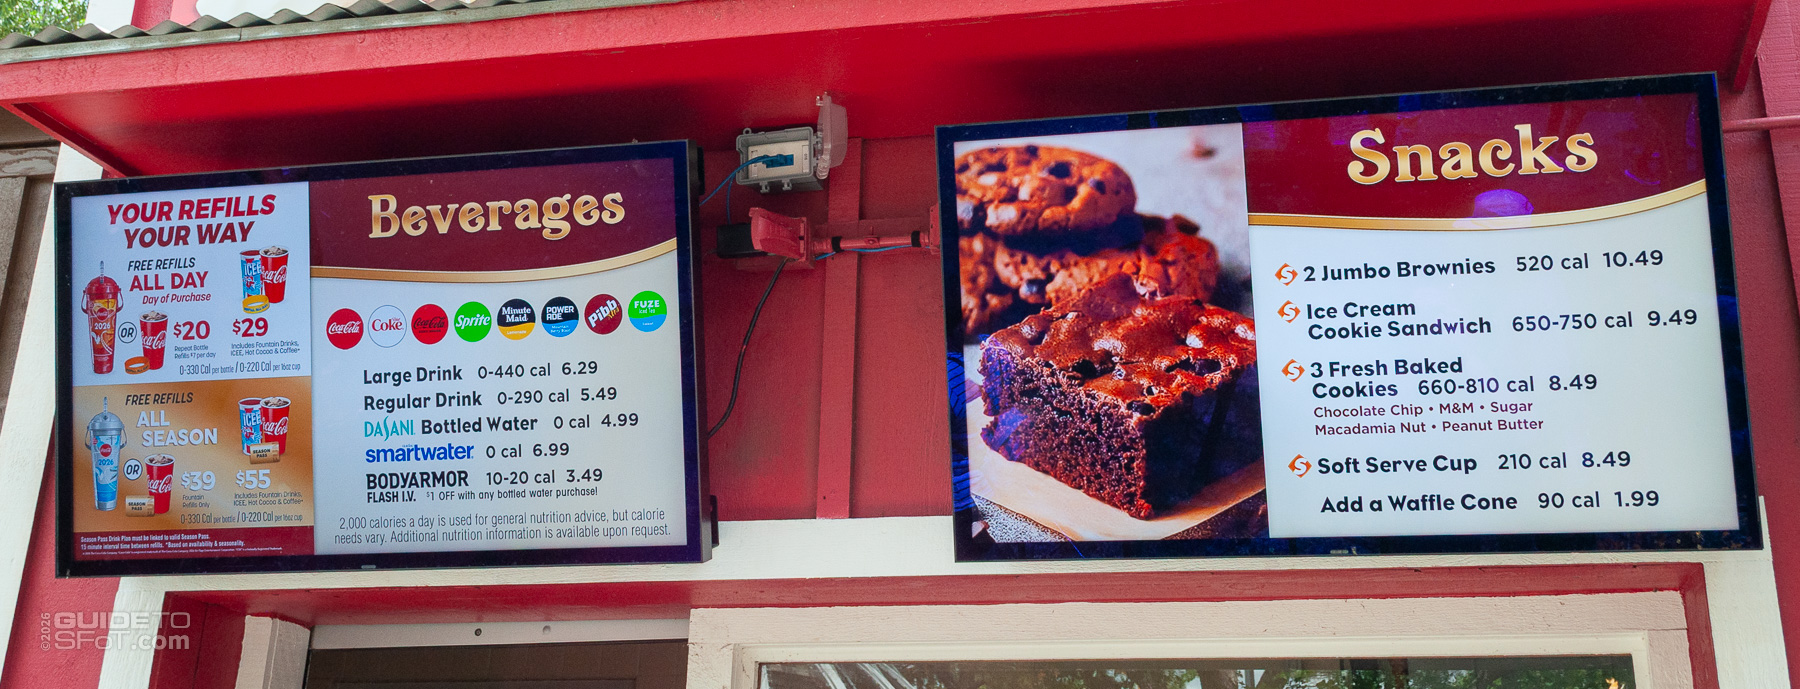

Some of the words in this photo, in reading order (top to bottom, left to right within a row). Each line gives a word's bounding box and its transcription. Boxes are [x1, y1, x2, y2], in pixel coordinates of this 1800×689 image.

[1347, 123, 1598, 185] Snacks
[107, 201, 173, 224] YOUR
[178, 194, 276, 220] REFILLS
[367, 192, 626, 241] Beverages
[124, 226, 190, 249] YOUR
[197, 221, 255, 244] WAY
[128, 259, 153, 271] FREE
[155, 257, 196, 270] REFILLS
[1303, 265, 1316, 282] 2
[1321, 262, 1390, 281] Jumbo
[1397, 258, 1496, 278] Brownies
[1515, 255, 1554, 272] 520
[1561, 253, 1589, 270] cal
[1603, 250, 1663, 268] 10.49
[129, 274, 164, 291] ALL
[171, 271, 208, 289] DAY
[142, 295, 159, 305] Day
[161, 294, 170, 303] of
[171, 292, 211, 303] Purchase
[634, 300, 660, 308] FUZE
[502, 306, 531, 315] Minute
[506, 314, 528, 322] Maid
[546, 305, 574, 313] POWER
[588, 299, 617, 328] Pibb
[1307, 303, 1337, 320] Ice
[1343, 300, 1416, 318] Cream
[173, 321, 210, 340] $20
[232, 317, 269, 338] $29
[372, 318, 403, 332] Coke
[456, 314, 491, 330] Sprite
[1308, 322, 1382, 341] Cookie
[1388, 317, 1492, 338] Sandwich
[1512, 313, 1597, 333] 650-750
[1604, 312, 1633, 329] cal
[1647, 309, 1697, 327] 9.49
[121, 328, 134, 337] OR
[363, 370, 412, 387] Large
[416, 365, 463, 382] Drink
[478, 364, 525, 380] 0-440
[530, 363, 551, 377] cal
[561, 361, 598, 375] 6.29
[1310, 362, 1323, 379] 3
[1329, 360, 1388, 378] Fresh
[1394, 357, 1463, 375] Baked
[1312, 380, 1398, 399] Cookies
[1418, 377, 1500, 396] 660-810
[1506, 376, 1535, 393] cal
[1549, 374, 1597, 391] 8.49
[125, 394, 151, 406] FREE
[153, 392, 193, 404] REFILLS
[364, 394, 431, 413] Regular
[435, 391, 482, 407] Drink
[497, 390, 543, 405] 0-290
[548, 388, 570, 403] cal
[580, 387, 617, 401] 5.49
[137, 410, 170, 428] ALL
[1313, 404, 1386, 419] Chocolate
[1390, 403, 1424, 419] Chip
[1439, 401, 1474, 415] M&M
[1490, 400, 1533, 418] Sugar
[364, 415, 415, 442] DASANI
[421, 417, 482, 435] Bottled
[486, 416, 538, 432] Water
[553, 415, 564, 429] 0
[569, 414, 590, 429] cal
[601, 413, 639, 427] 4.99
[1315, 422, 1396, 436] Macadamia
[1400, 421, 1426, 434] Nut
[1442, 419, 1493, 433] Peanut
[1498, 417, 1544, 431] Butter
[142, 428, 218, 447] SEASON
[365, 443, 473, 464] smartwater
[486, 446, 496, 459] 0
[501, 444, 522, 458] cal
[532, 442, 570, 457] 6.99
[1317, 457, 1361, 475] Soft
[1365, 456, 1428, 474] Serve
[1433, 454, 1477, 475] Cup
[1498, 453, 1533, 471] 210
[1539, 452, 1567, 469] cal
[1581, 451, 1631, 468] 8.49
[126, 465, 140, 475] OR
[236, 469, 271, 490] $55
[366, 470, 469, 490] BODYARMOR
[486, 471, 529, 485] 10-20
[534, 469, 555, 484] cal
[566, 468, 603, 482] 3.49
[181, 471, 216, 491] $39
[367, 491, 399, 504] FLASH
[401, 490, 416, 502] I.V.
[426, 491, 435, 501] $1
[439, 490, 455, 500] OFF
[457, 489, 476, 500] with
[479, 490, 494, 501] any
[497, 487, 527, 499] bottled
[529, 488, 553, 498] water
[555, 486, 598, 499] purchase!
[1321, 496, 1364, 513] Add
[1369, 500, 1383, 512] a
[1388, 494, 1455, 512] Waffle
[1461, 493, 1518, 511] Cone
[1538, 492, 1565, 509] 90
[1572, 491, 1600, 508] cal
[1614, 490, 1660, 507] 1.99
[339, 517, 367, 530] 2,000
[369, 515, 406, 528] calories
[409, 519, 415, 527] a
[418, 514, 435, 529] day
[437, 514, 446, 526] is
[449, 513, 472, 525] used
[475, 512, 489, 525] for
[491, 511, 527, 527] general
[530, 511, 572, 524] nutrition
[574, 509, 609, 524] advice,
[612, 509, 628, 522] but
[631, 508, 665, 521] calorie
[334, 531, 362, 544] needs
[365, 533, 387, 546] vary.
[390, 529, 439, 542] Additional
[442, 528, 483, 541] nutrition
[485, 527, 542, 540] information
[545, 526, 553, 539] is
[555, 525, 600, 538] available
[602, 527, 628, 540] upon
[631, 523, 671, 538] request.
